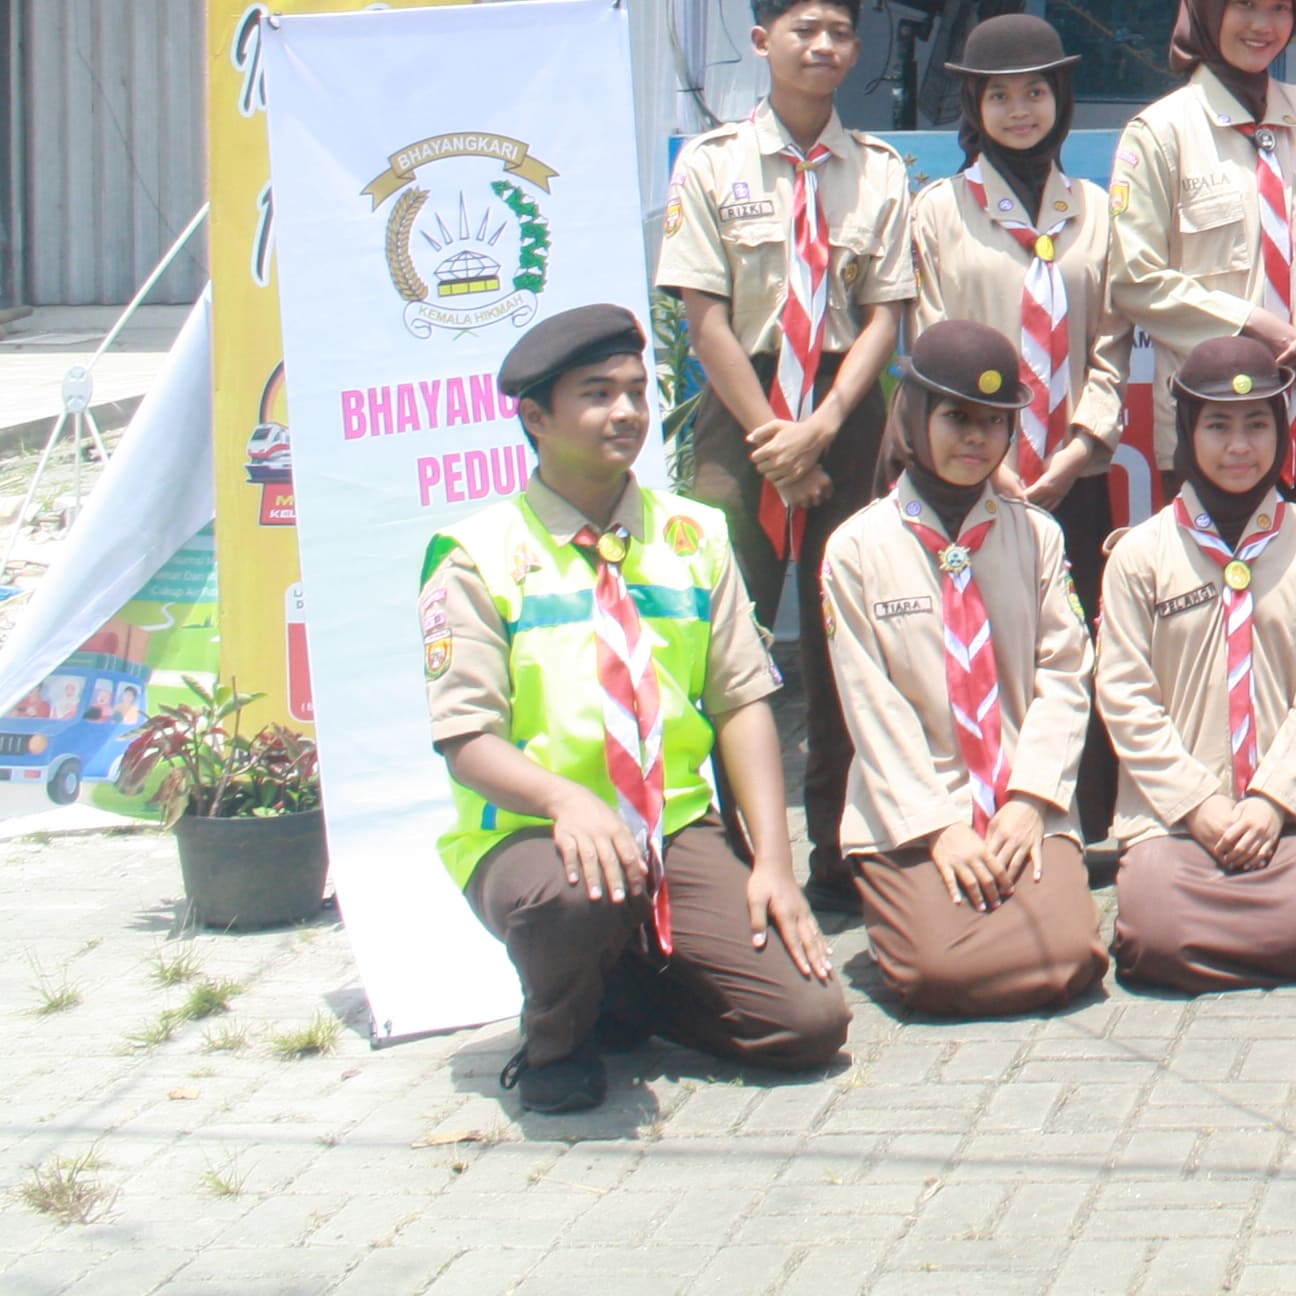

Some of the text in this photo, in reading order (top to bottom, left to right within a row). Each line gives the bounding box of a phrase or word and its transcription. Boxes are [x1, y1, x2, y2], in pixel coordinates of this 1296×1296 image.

[397, 136, 519, 169] BHAYANGKARI
[418, 294, 525, 325] KEMALA HIKMAH
[341, 372, 521, 441] BHAYAN
[882, 599, 921, 616] TIARA
